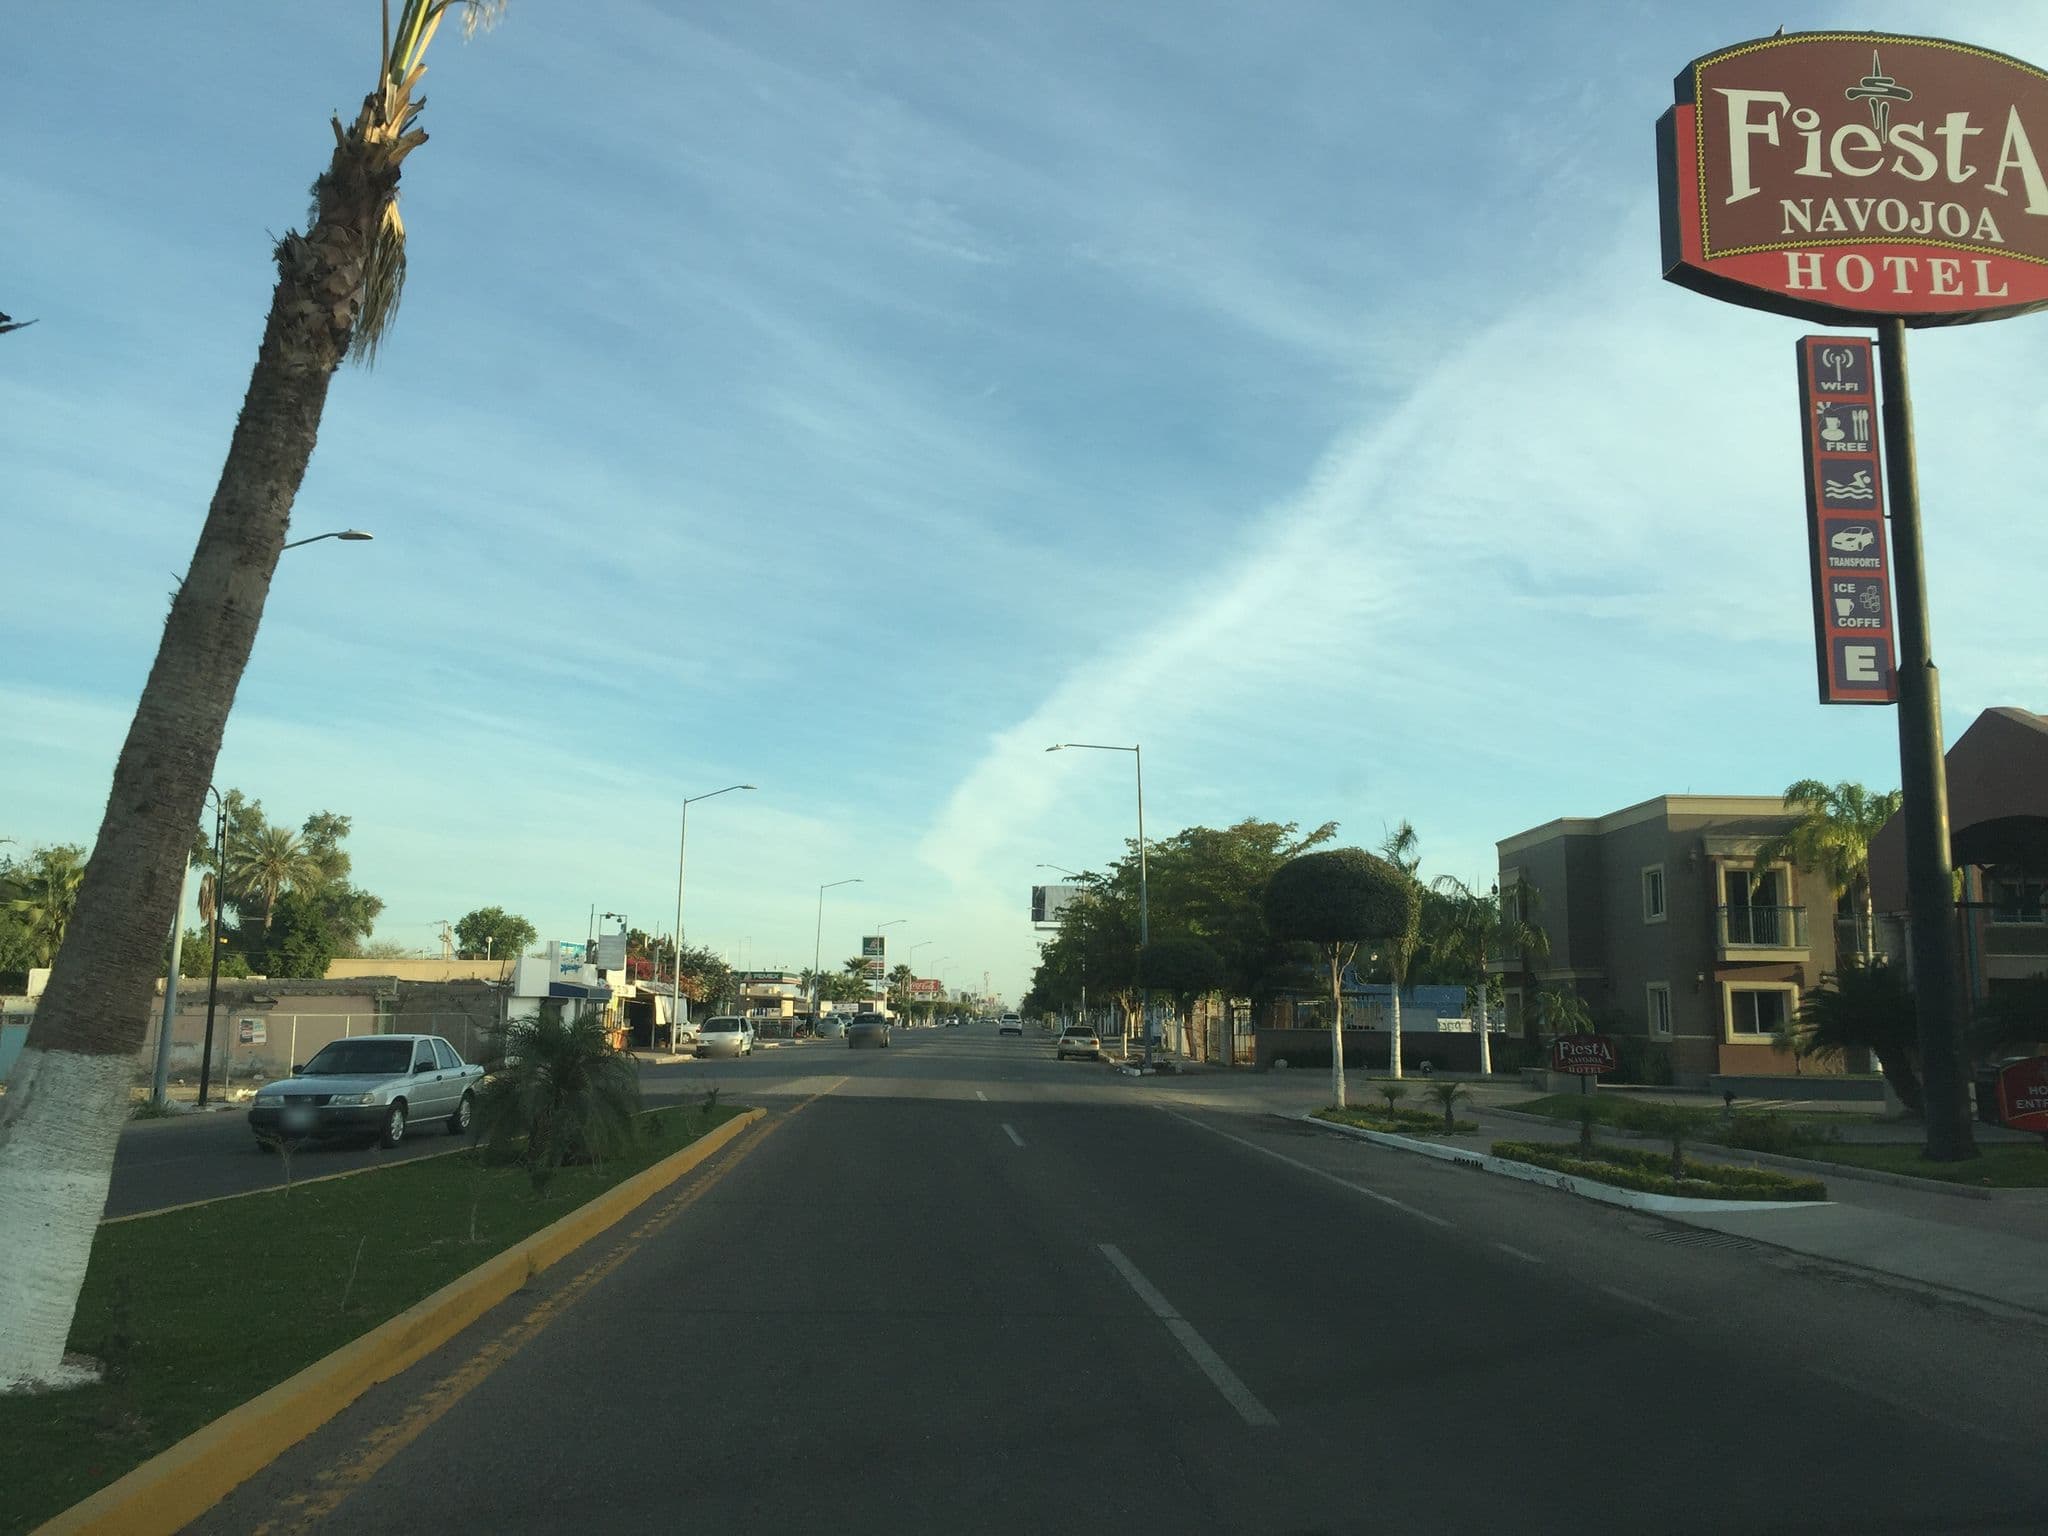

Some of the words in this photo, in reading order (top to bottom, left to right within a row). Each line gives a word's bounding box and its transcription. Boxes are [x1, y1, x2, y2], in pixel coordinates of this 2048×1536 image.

[1780, 197, 2005, 243] NAVOJOA
[1783, 251, 2009, 297] HOTEL
[1826, 442, 1867, 451] FREE
[1829, 557, 1880, 568] TRANSPORTE
[1833, 583, 1856, 593] ICE
[1837, 617, 1881, 628] COFFE
[1844, 645, 1879, 681] E
[1567, 1066, 1604, 1074] HOTEL
